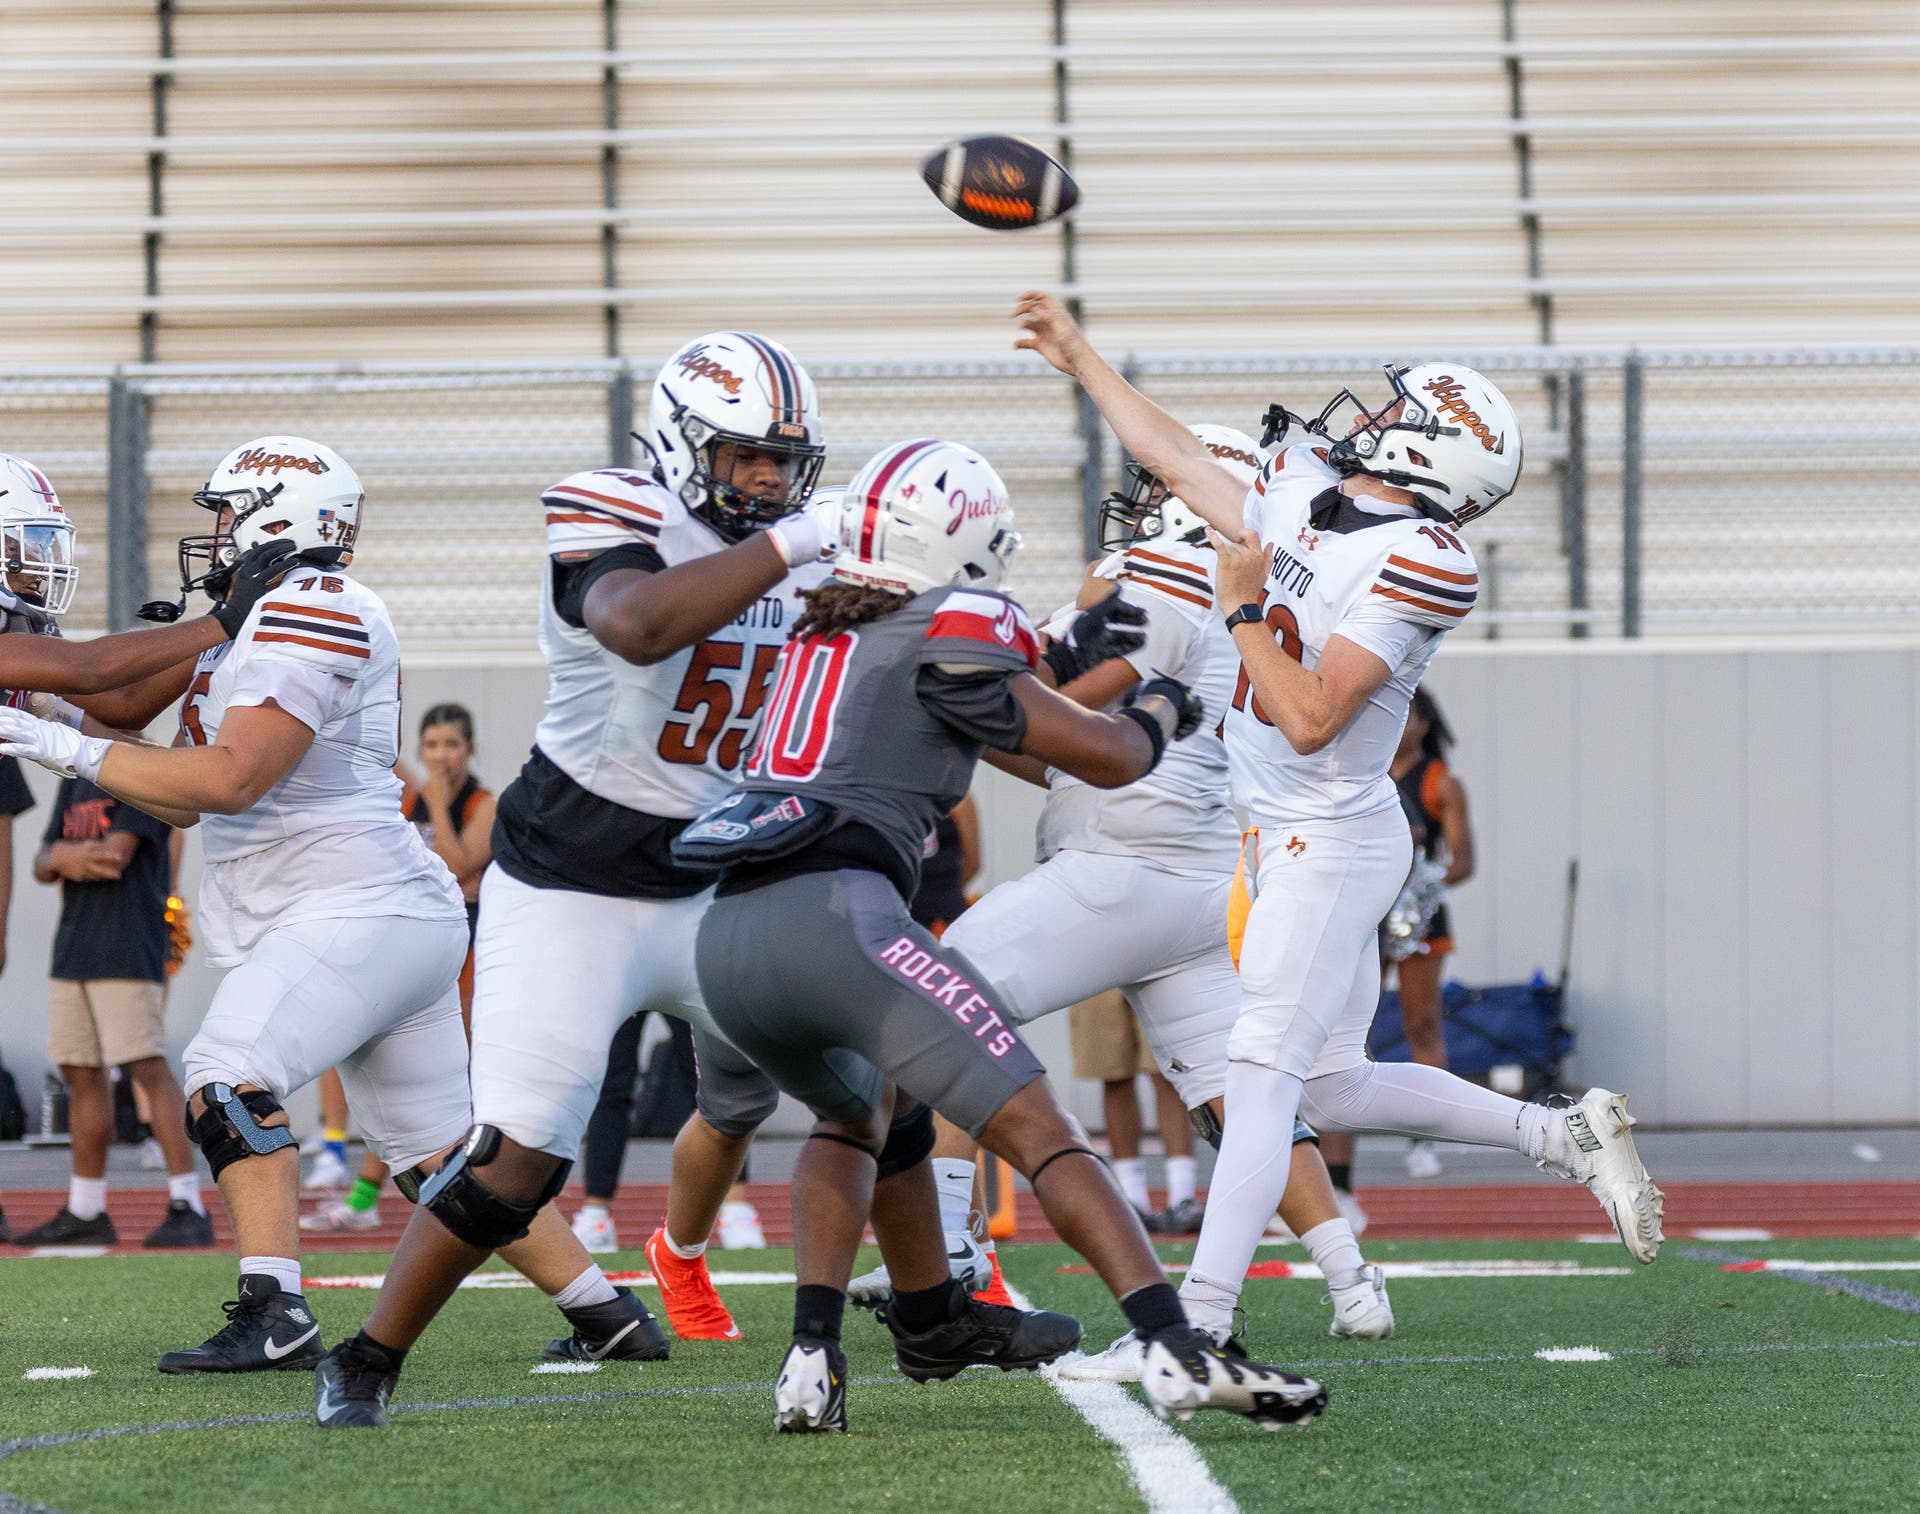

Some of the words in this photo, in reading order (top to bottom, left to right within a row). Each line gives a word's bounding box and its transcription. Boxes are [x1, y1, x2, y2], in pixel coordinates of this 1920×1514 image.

[1422, 375, 1498, 452] Hippos
[234, 447, 323, 476] Hippos
[293, 576, 344, 593] 75
[1271, 546, 1314, 599] HUTTO
[657, 640, 783, 772] 55
[745, 626, 860, 783] 10
[880, 936, 1016, 1058] ROCKETS
[1565, 1112, 1603, 1153] NIKE
